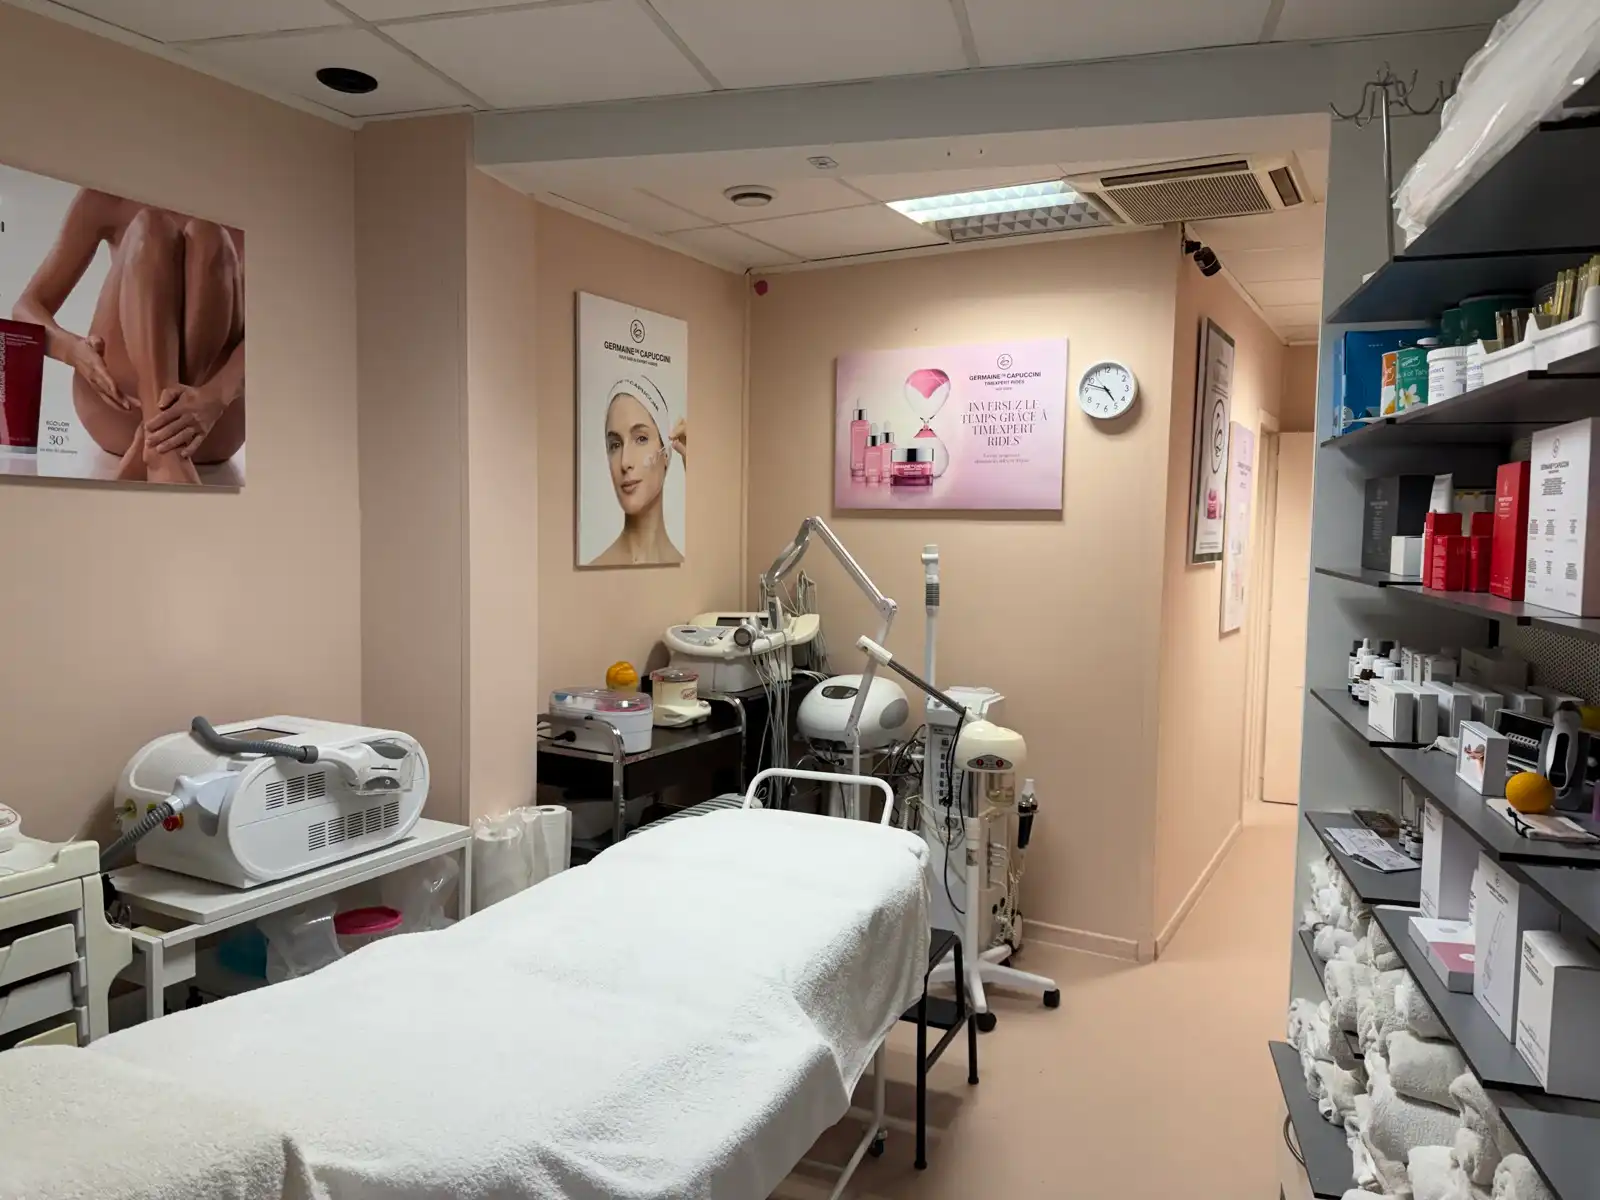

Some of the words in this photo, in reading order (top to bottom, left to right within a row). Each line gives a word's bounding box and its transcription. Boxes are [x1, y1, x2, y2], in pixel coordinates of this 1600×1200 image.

[604, 341, 635, 355] GERMAINE
[640, 350, 671, 363] CAPUCCINI
[1104, 366, 1111, 374] 12
[969, 373, 1001, 381] GERMAINE
[1006, 370, 1042, 379] CAPUCCINI
[1121, 374, 1127, 383] 2
[1088, 377, 1095, 385] 10
[1124, 384, 1130, 393] 3
[1087, 396, 1093, 404] 8
[968, 400, 1022, 412] INVERSEZ
[1025, 399, 1039, 410] LE
[1103, 404, 1109, 413] 6
[1113, 402, 1119, 410] 5
[960, 412, 997, 424] TEMPS
[971, 423, 1036, 436] TIMEXPERT
[987, 435, 1021, 447] RIDES
